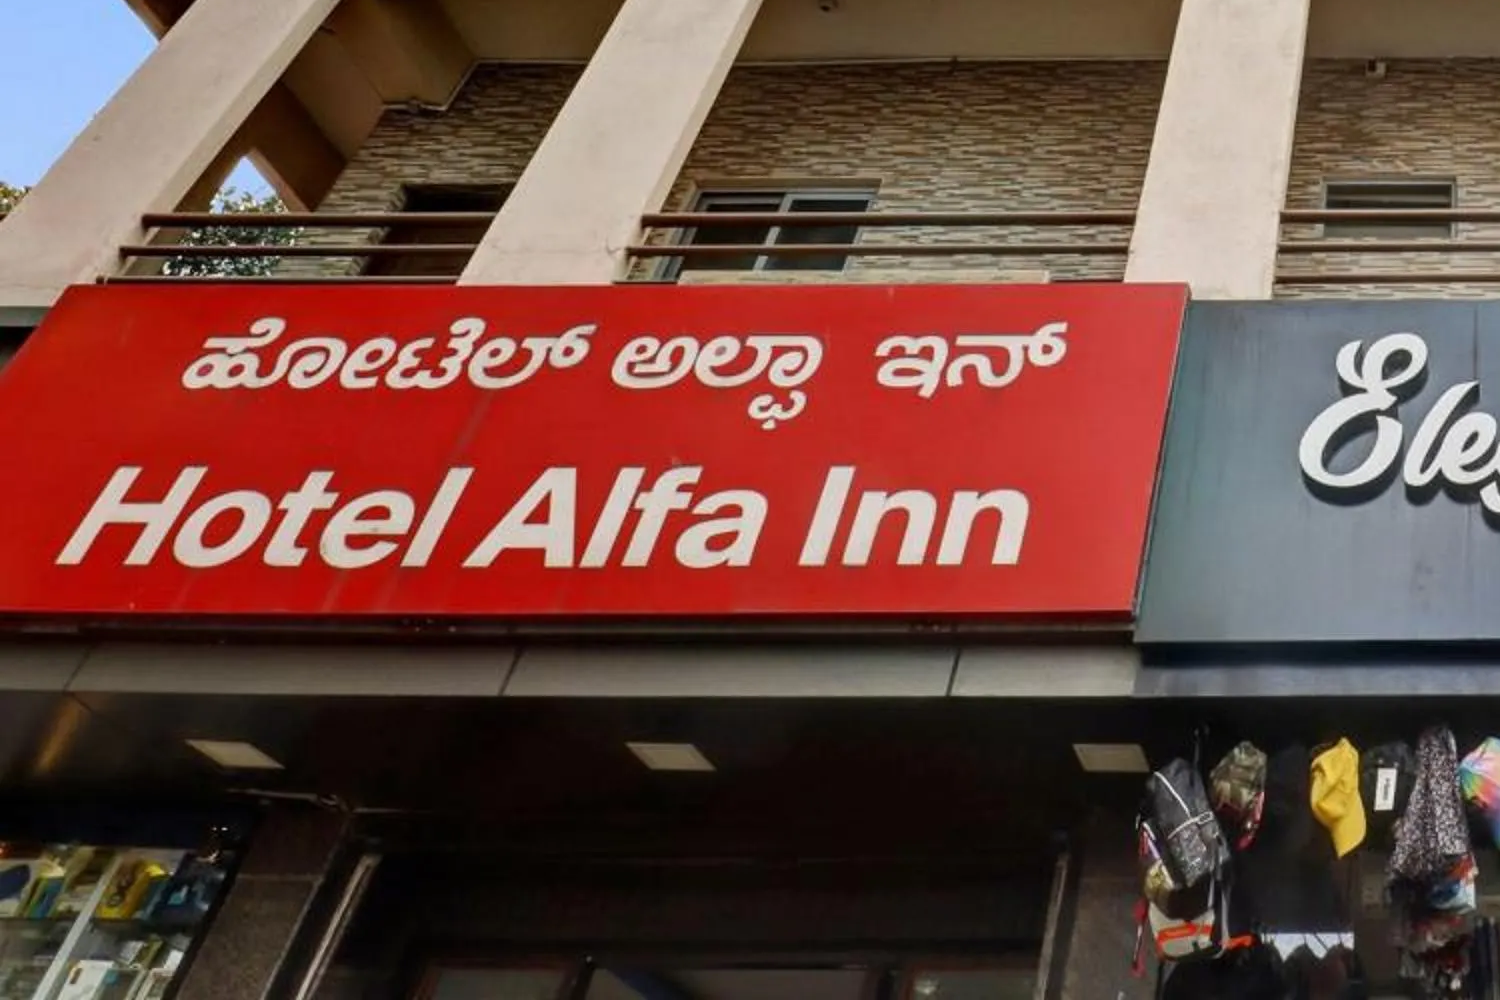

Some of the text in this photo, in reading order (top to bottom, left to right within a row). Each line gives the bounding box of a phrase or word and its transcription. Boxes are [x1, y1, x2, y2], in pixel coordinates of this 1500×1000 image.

[182, 317, 597, 389] ಹೋಟೆಲ್
[875, 322, 1068, 398] ಇನ್
[56, 466, 1029, 569] Hotel Alfa Inn
